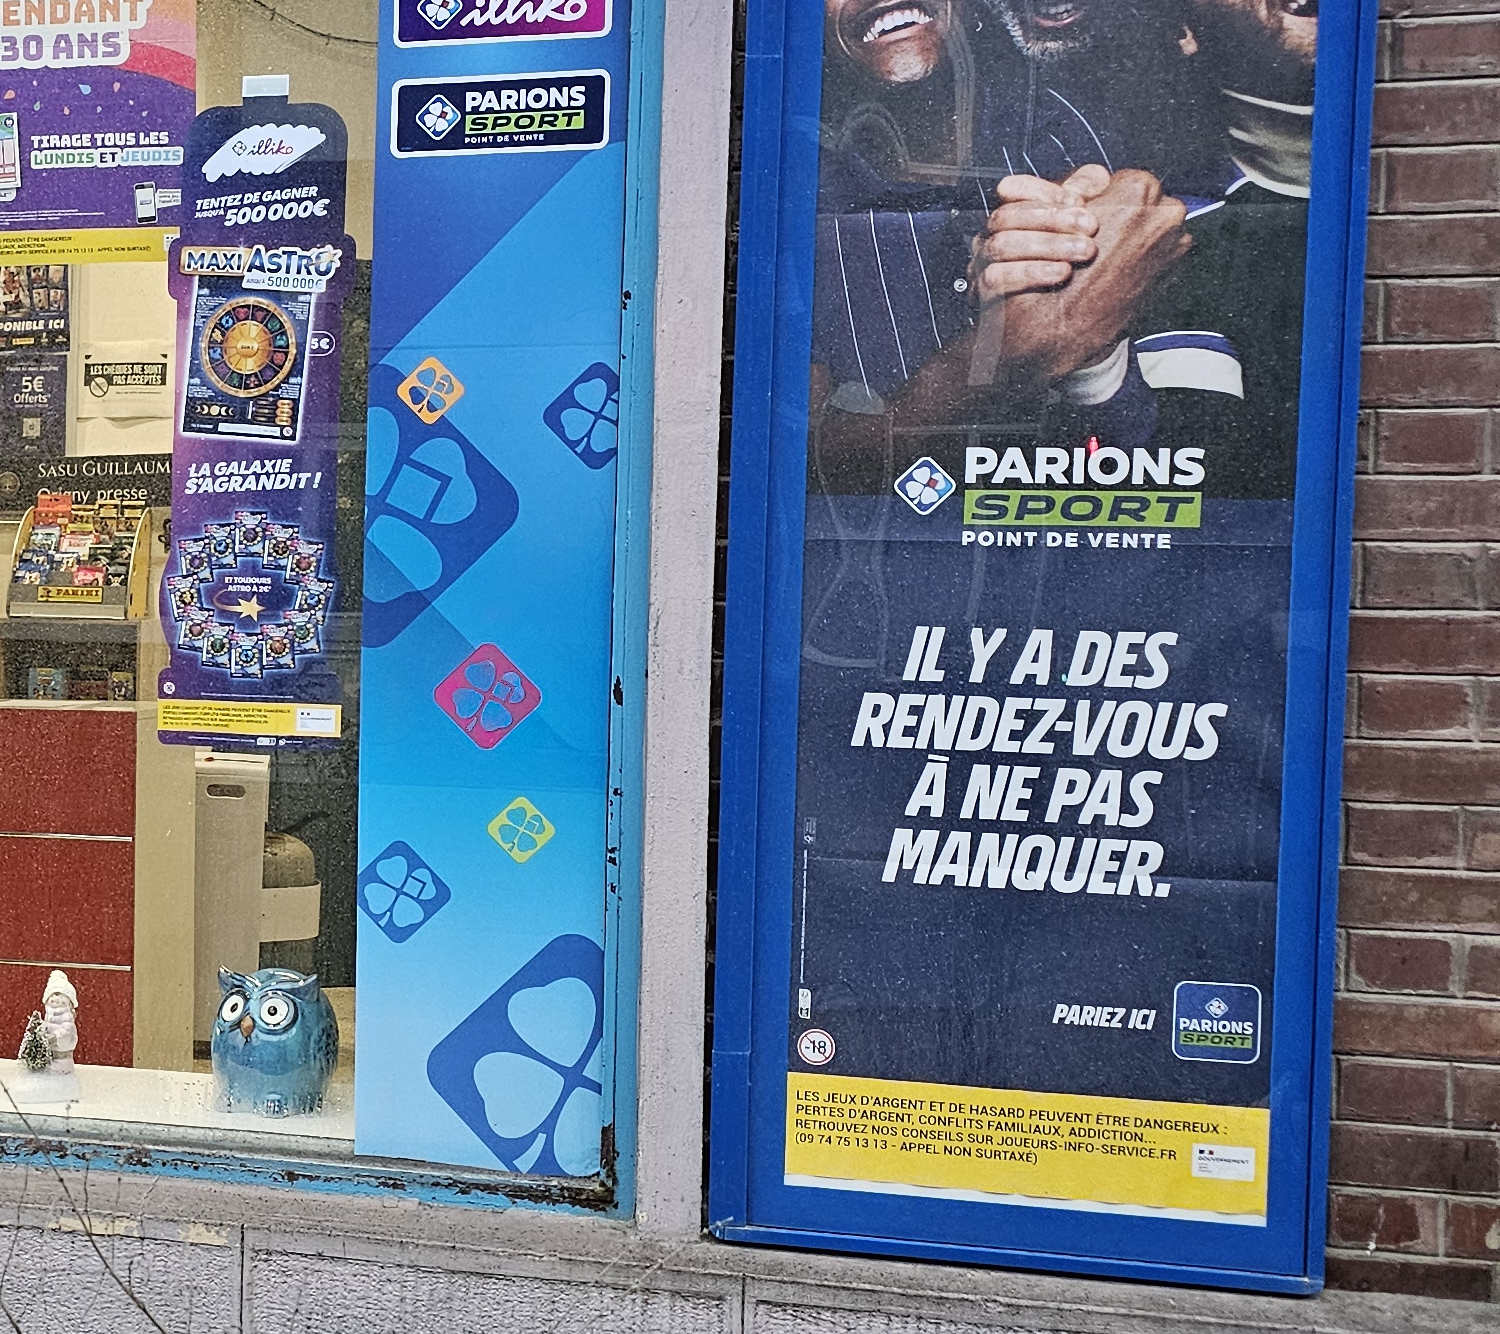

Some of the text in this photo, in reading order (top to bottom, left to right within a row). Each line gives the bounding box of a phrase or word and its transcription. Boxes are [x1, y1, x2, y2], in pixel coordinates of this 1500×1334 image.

[1, 31, 122, 61] 30 ANS
[466, 86, 586, 111] PARIONS
[469, 112, 581, 131] SPORT
[31, 132, 169, 148] TIRAGE TOUS LES
[247, 138, 293, 156] illiko
[465, 135, 494, 143] POINT
[34, 150, 181, 166] LUNDIS ET JEUDIS
[196, 195, 241, 210] TENTEZ
[244, 192, 260, 203] DE
[262, 186, 318, 201] GAGNER
[224, 207, 266, 226] 500
[268, 199, 330, 221] 000€
[186, 248, 336, 276] MAXI ASTRO
[267, 277, 289, 287] 500
[49, 319, 64, 328] ICI
[310, 338, 330, 349] 5€
[90, 366, 102, 375] LES
[133, 365, 143, 374] NE
[144, 365, 162, 374] SONT
[22, 376, 44, 392] 5€
[113, 376, 126, 384] PAS
[14, 393, 47, 403] Offerts
[38, 462, 78, 477] SASU
[188, 459, 292, 477] LA GALAXIE
[965, 447, 1205, 485] PARIONS
[185, 473, 312, 494] S'AGRANDIT
[98, 488, 147, 501] presse
[971, 494, 1195, 523] SPORT
[962, 530, 1172, 549] POINT DE VENTE
[228, 585, 249, 593] ASTRO
[233, 577, 271, 585] TOUJOURS
[56, 589, 100, 597] PANINI
[902, 626, 1179, 689] IL Y A DES
[850, 691, 1229, 760] RENDEZ-VOUS
[904, 754, 1163, 827] À NE PAS
[882, 827, 1171, 897] MANQUER.
[1052, 1004, 1156, 1030] PARIEZ ICI
[1180, 1018, 1253, 1034] PARIONS
[1182, 1034, 1250, 1046] SPORT
[797, 1090, 1219, 1134] LES JEUX D'ARGENT ET DE HASARD PEUVENT ÊTRE DANGEREUX
[796, 1104, 1156, 1144] PERTES D'ARGENT, CONFLITS FAMILIAUX, ADDICTION...
[796, 1119, 1177, 1160] RETROUVEZ NOS CONSEILS SUR JOUEURS-INFO-SERVICE.FR
[795, 1133, 1038, 1165] (09 74 75 13 13 APPEL NON SURTAXÉ)
